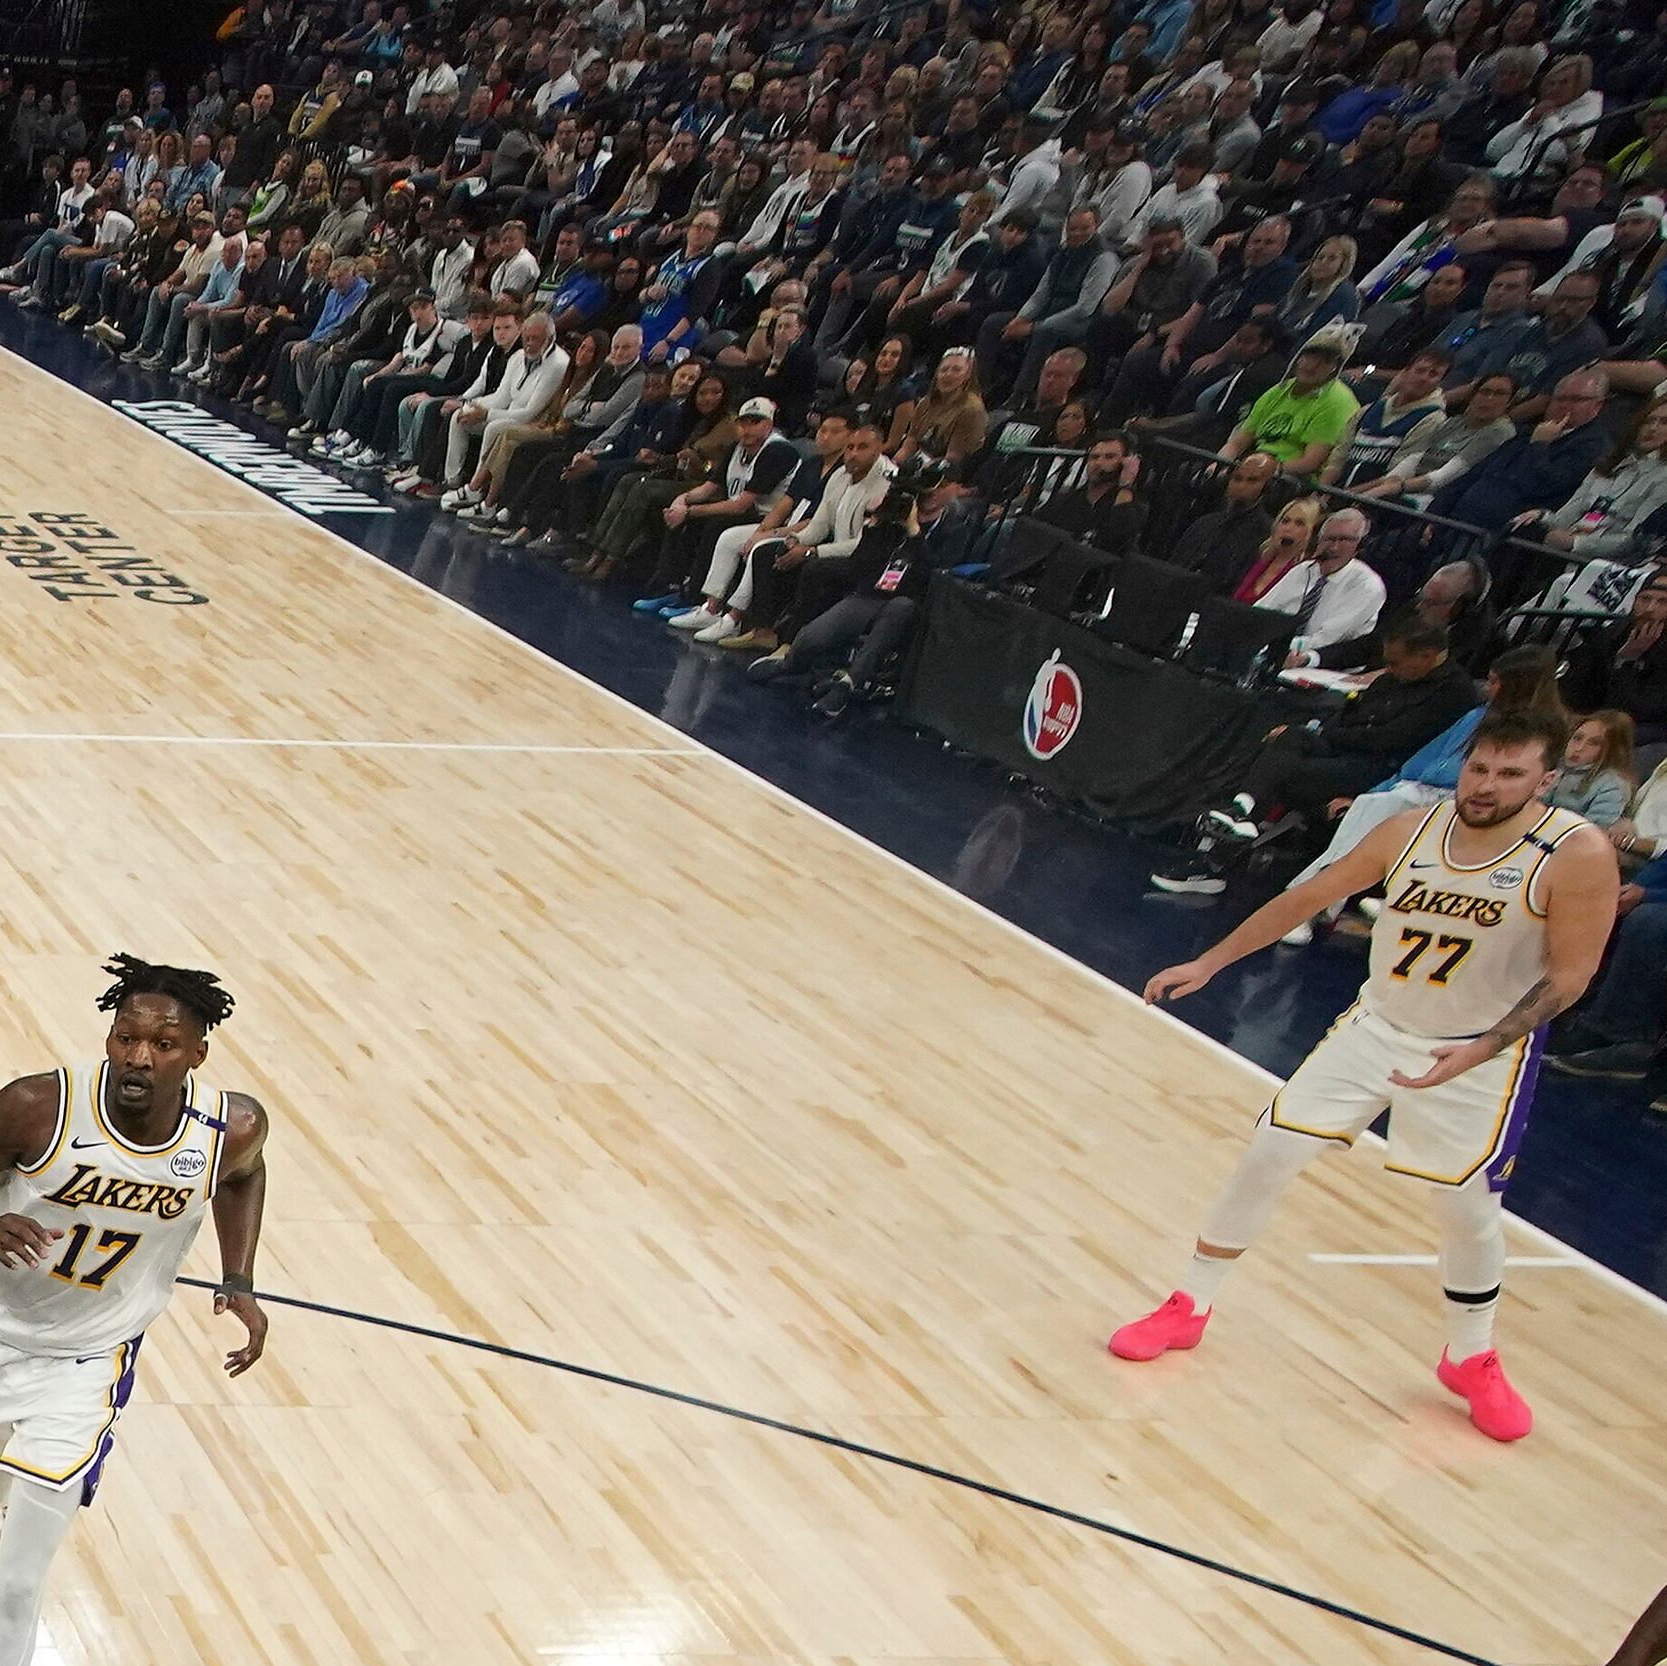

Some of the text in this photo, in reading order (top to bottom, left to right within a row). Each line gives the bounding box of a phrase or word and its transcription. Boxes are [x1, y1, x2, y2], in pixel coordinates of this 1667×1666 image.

[27, 511, 210, 606] CENTER
[1388, 877, 1508, 928] LAKERS
[1388, 927, 1475, 989] 77
[42, 1163, 195, 1220] LAKERS
[49, 1223, 143, 1292] 17
